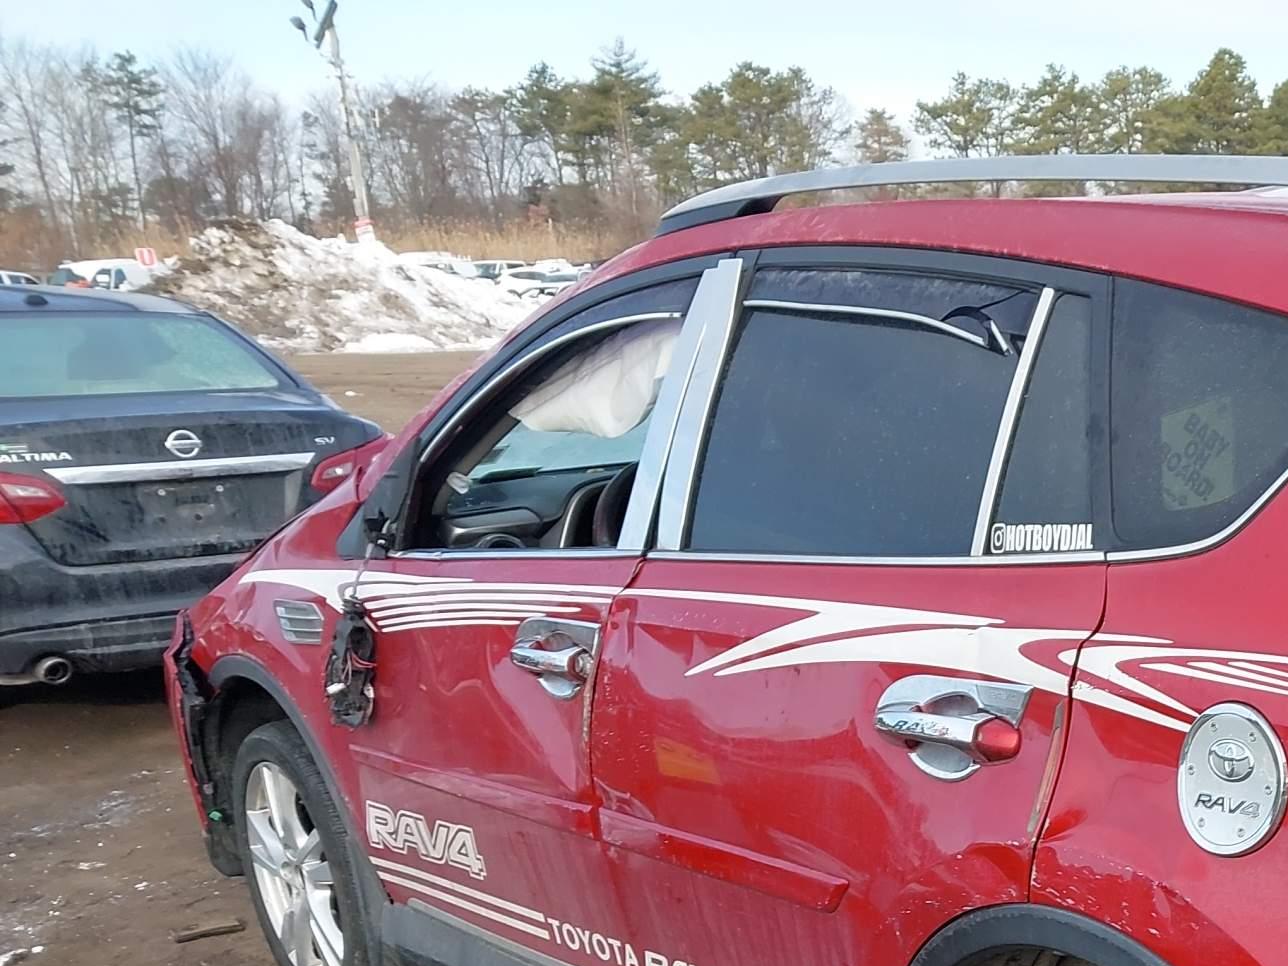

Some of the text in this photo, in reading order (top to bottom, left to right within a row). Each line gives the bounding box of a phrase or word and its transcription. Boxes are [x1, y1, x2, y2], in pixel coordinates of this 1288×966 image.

[313, 435, 336, 446] SV
[0, 451, 73, 463] ALTIMA
[1005, 523, 1094, 551] HOTBOYDJAL
[1194, 793, 1261, 818] RAV4
[365, 799, 487, 880] RAV4
